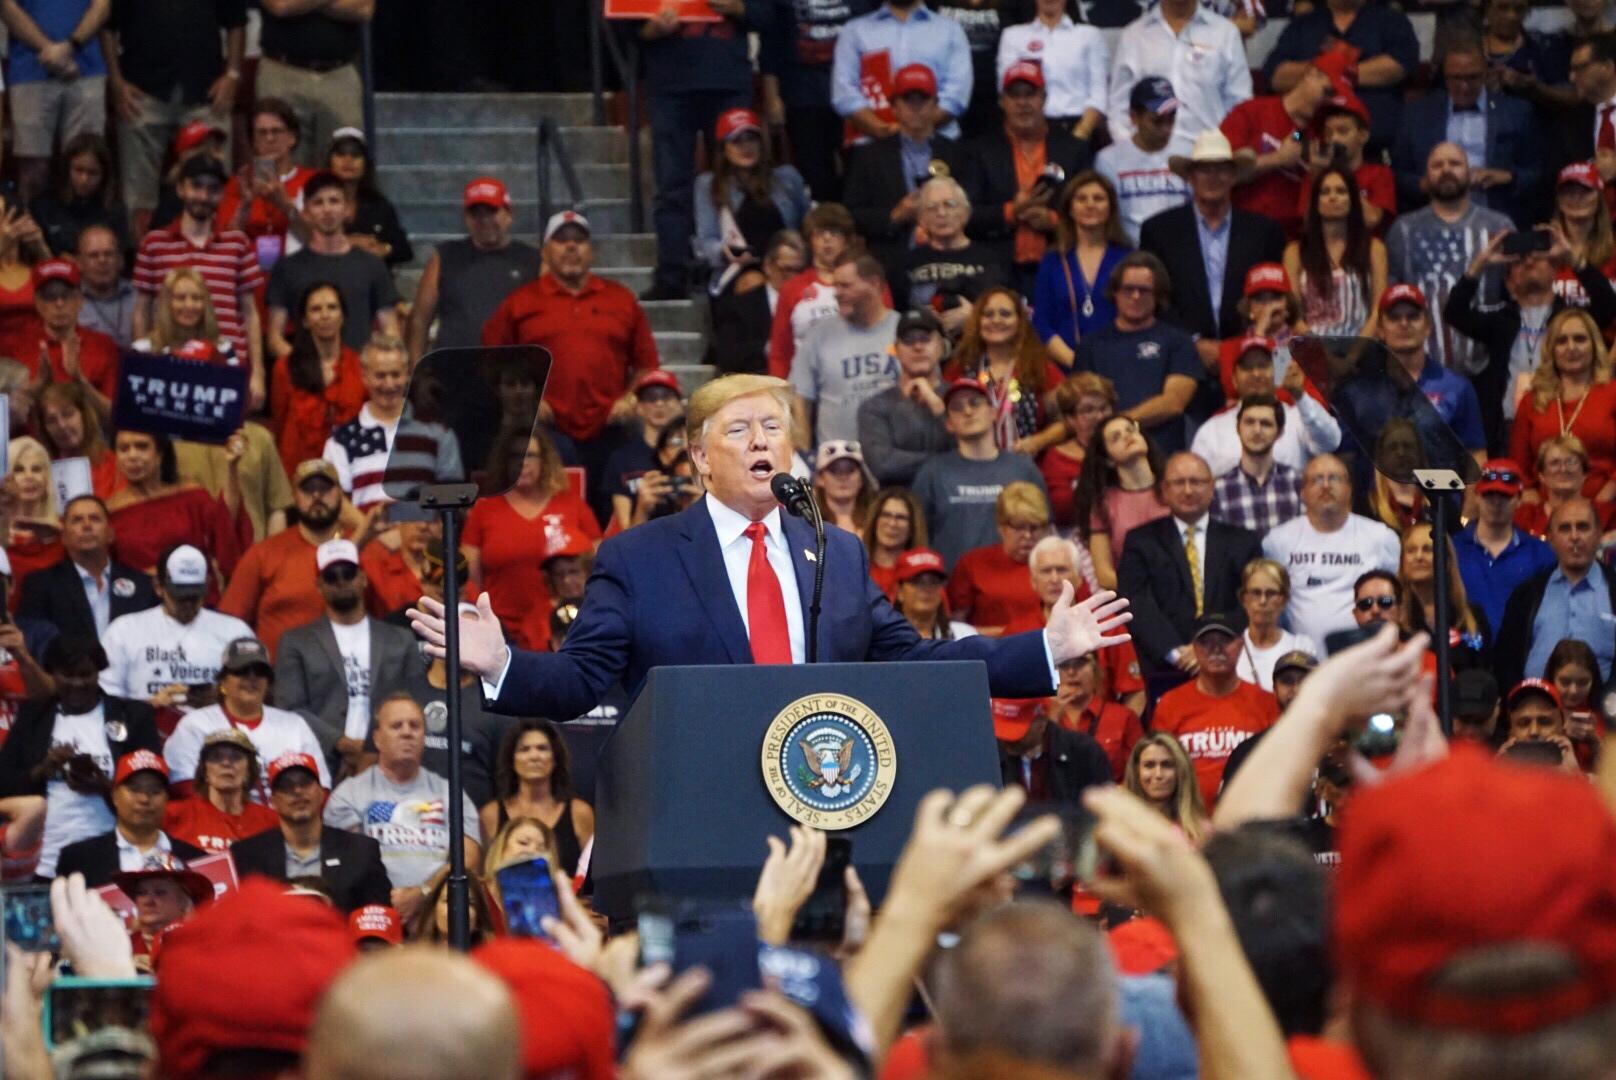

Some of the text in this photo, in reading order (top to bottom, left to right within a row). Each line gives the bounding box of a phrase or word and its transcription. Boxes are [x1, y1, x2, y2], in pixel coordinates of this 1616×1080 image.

[841, 352, 900, 380] USA
[127, 374, 238, 405] TRUMP
[956, 484, 1004, 497] TRUMP
[1289, 552, 1316, 566] JUST
[145, 643, 187, 662] Black
[169, 662, 219, 681] Voices
[767, 699, 892, 824] SEAL OF THE PRESIDENT OF THE UNITED STATES
